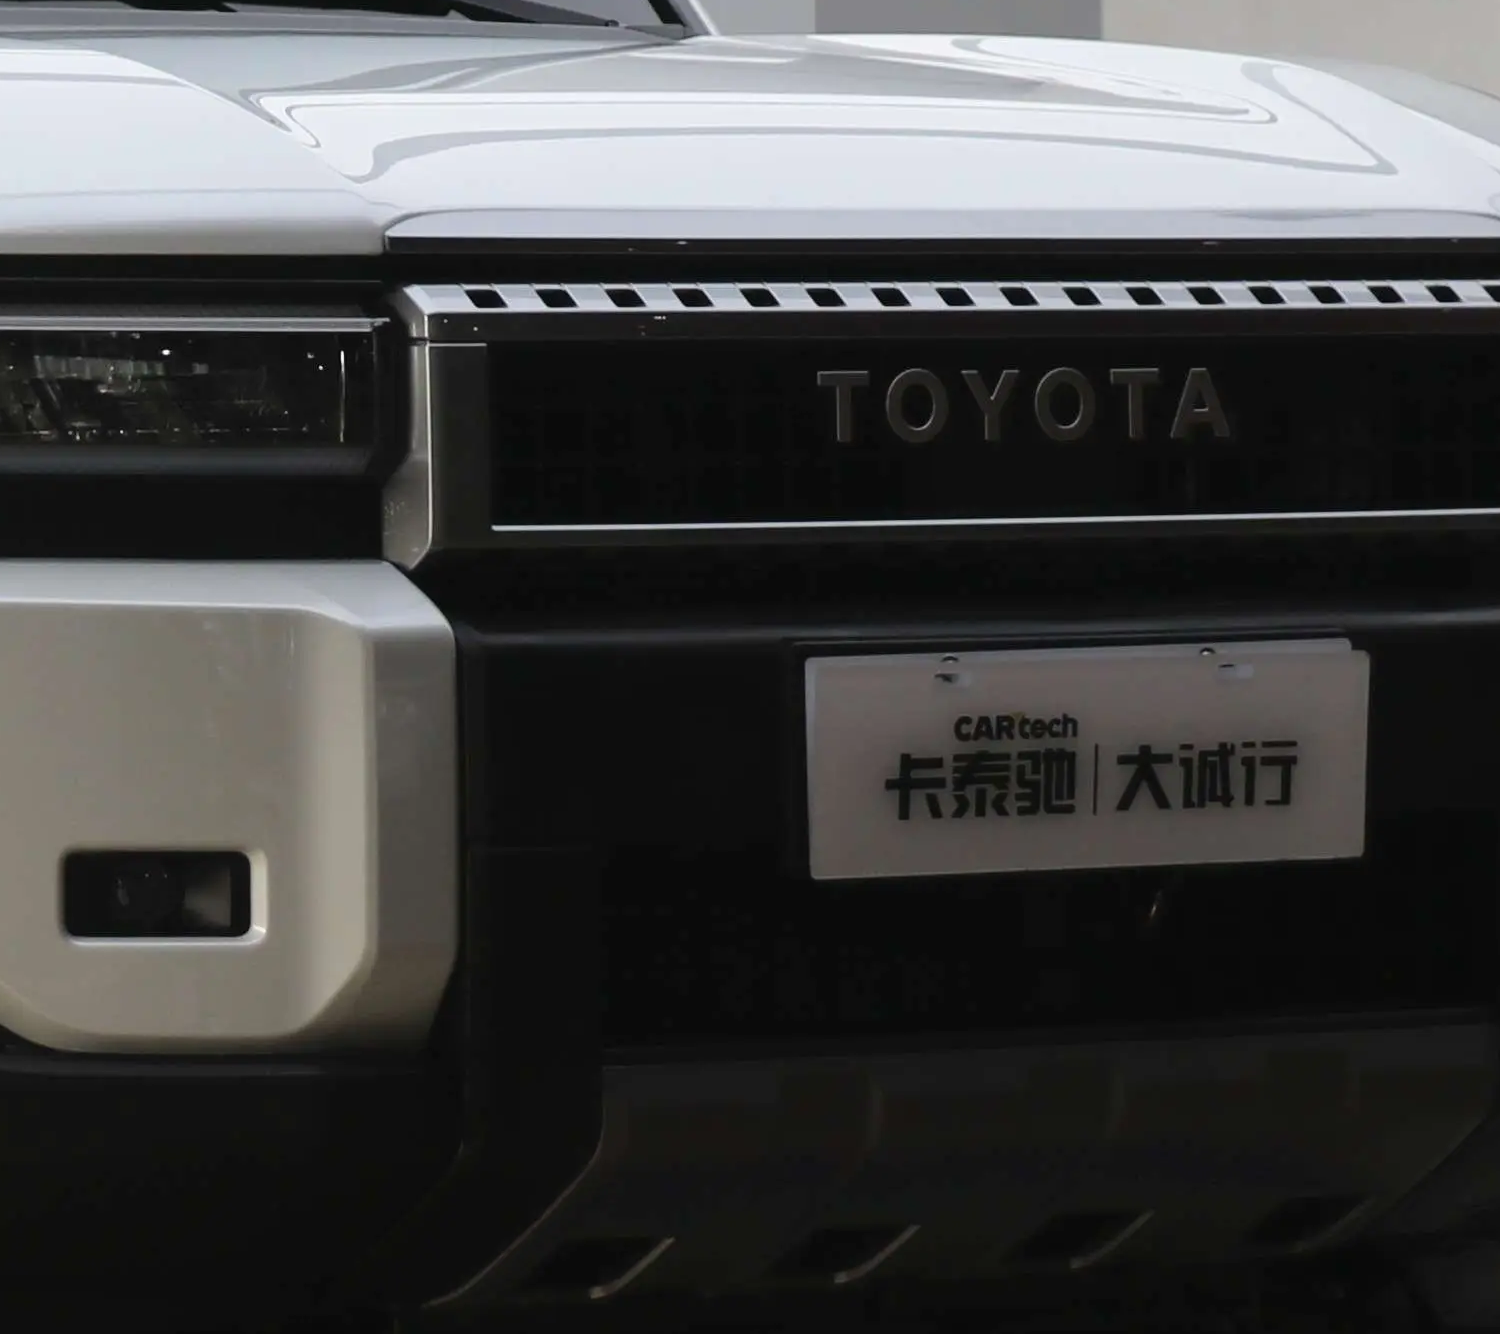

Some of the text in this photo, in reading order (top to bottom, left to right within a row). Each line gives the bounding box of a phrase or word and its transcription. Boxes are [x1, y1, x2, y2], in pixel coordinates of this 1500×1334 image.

[817, 367, 1230, 442] TOYOTA
[954, 713, 1078, 741] CARtech
[885, 740, 1298, 820] 卡泰驰 大诚行
